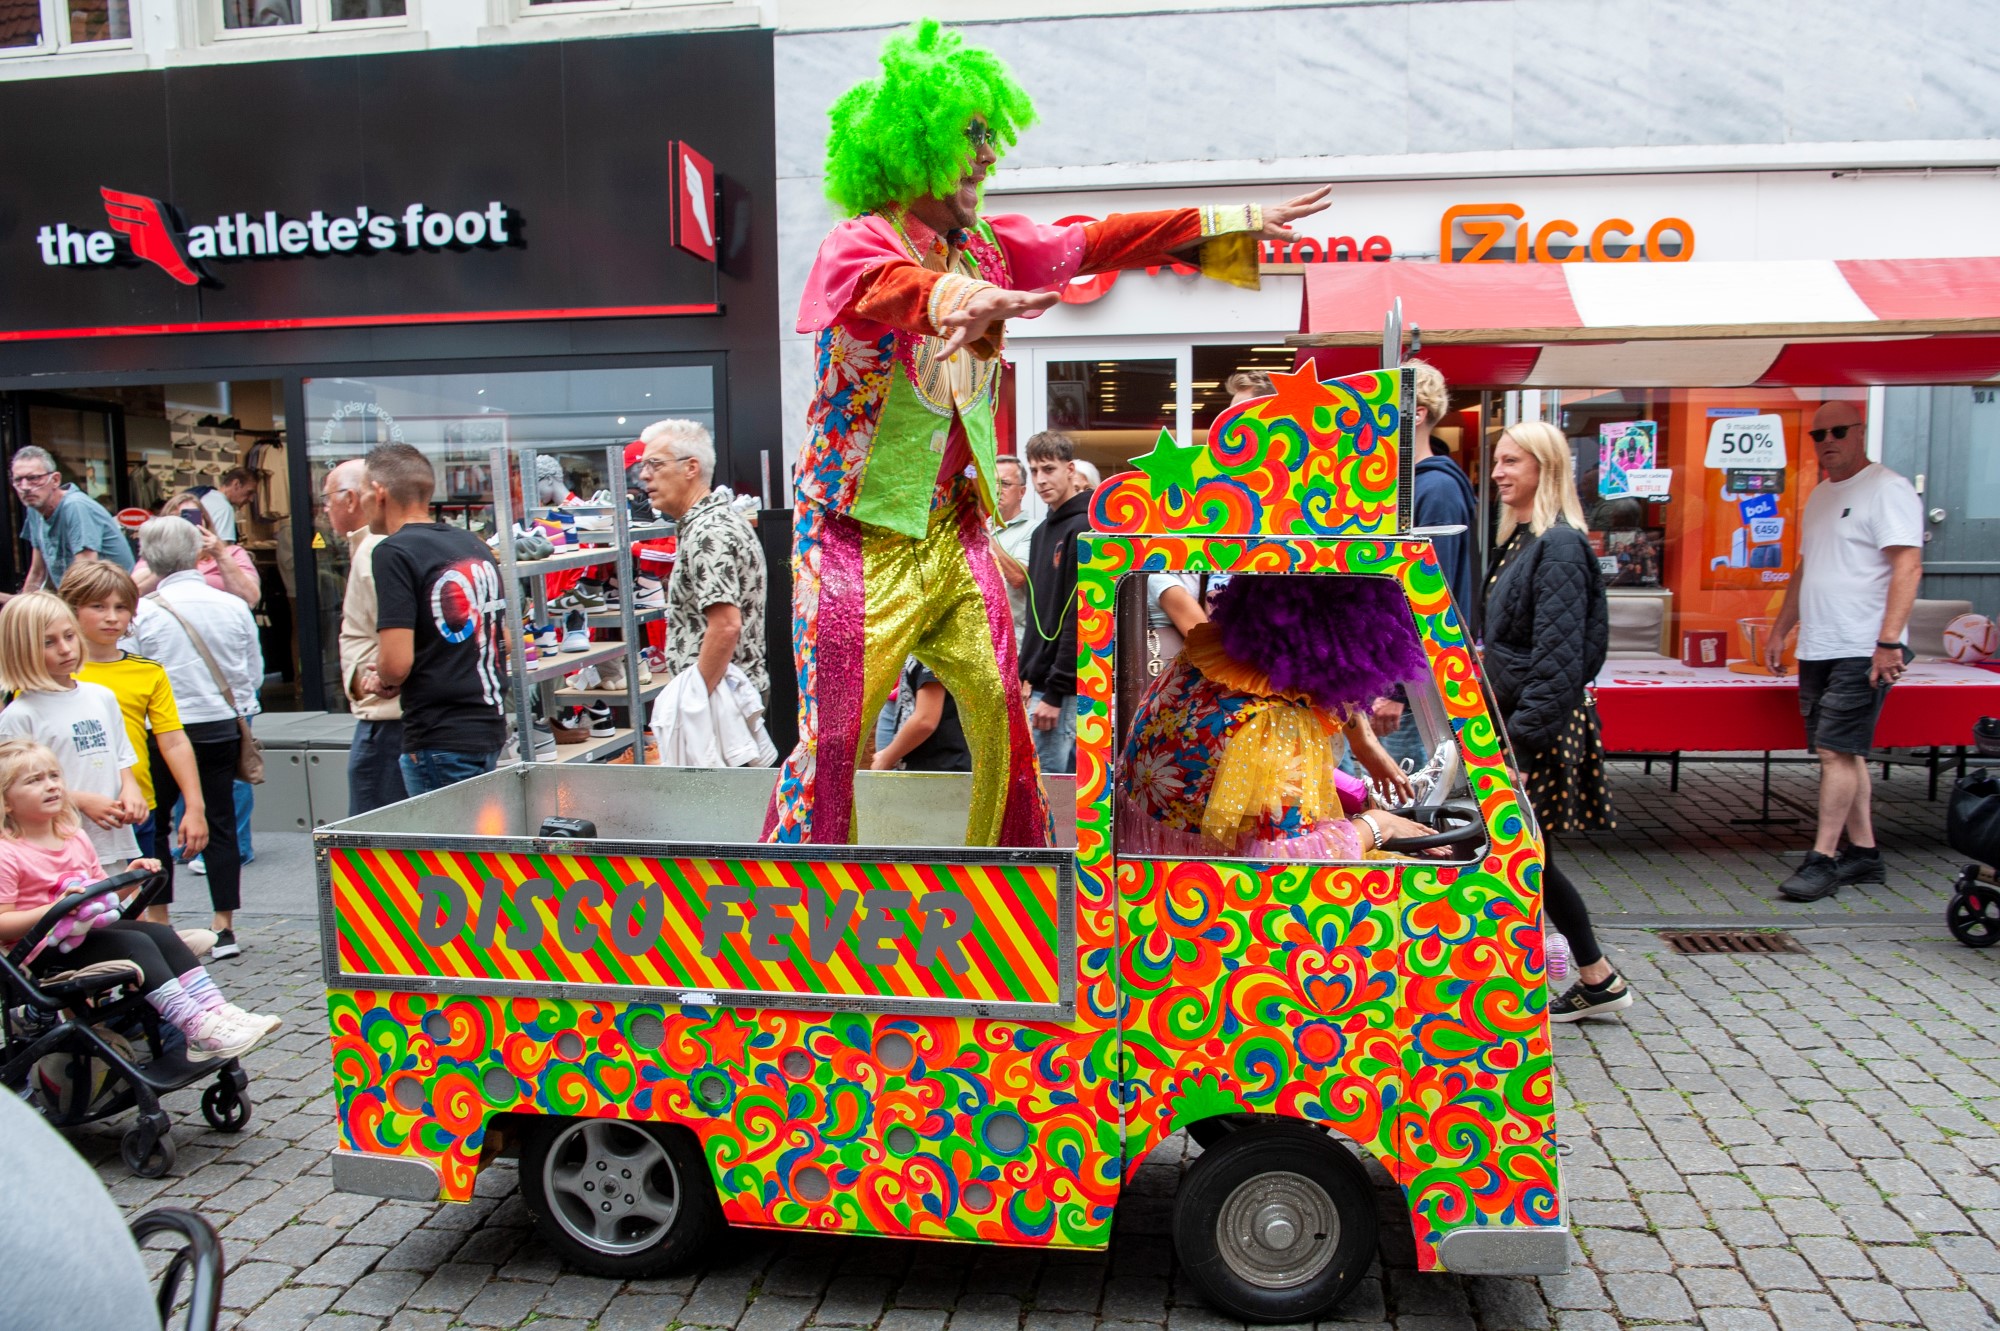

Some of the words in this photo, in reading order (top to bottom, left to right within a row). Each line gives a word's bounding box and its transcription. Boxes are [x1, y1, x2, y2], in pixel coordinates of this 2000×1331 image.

[36, 223, 115, 266] the
[187, 206, 397, 259] athlete's
[402, 201, 508, 247] foot
[343, 400, 367, 417] play
[366, 402, 394, 426] since
[1721, 432, 1773, 454] 50%
[1754, 525, 1780, 534] €450
[417, 874, 665, 957] DISCO
[700, 884, 975, 976] FEVER
